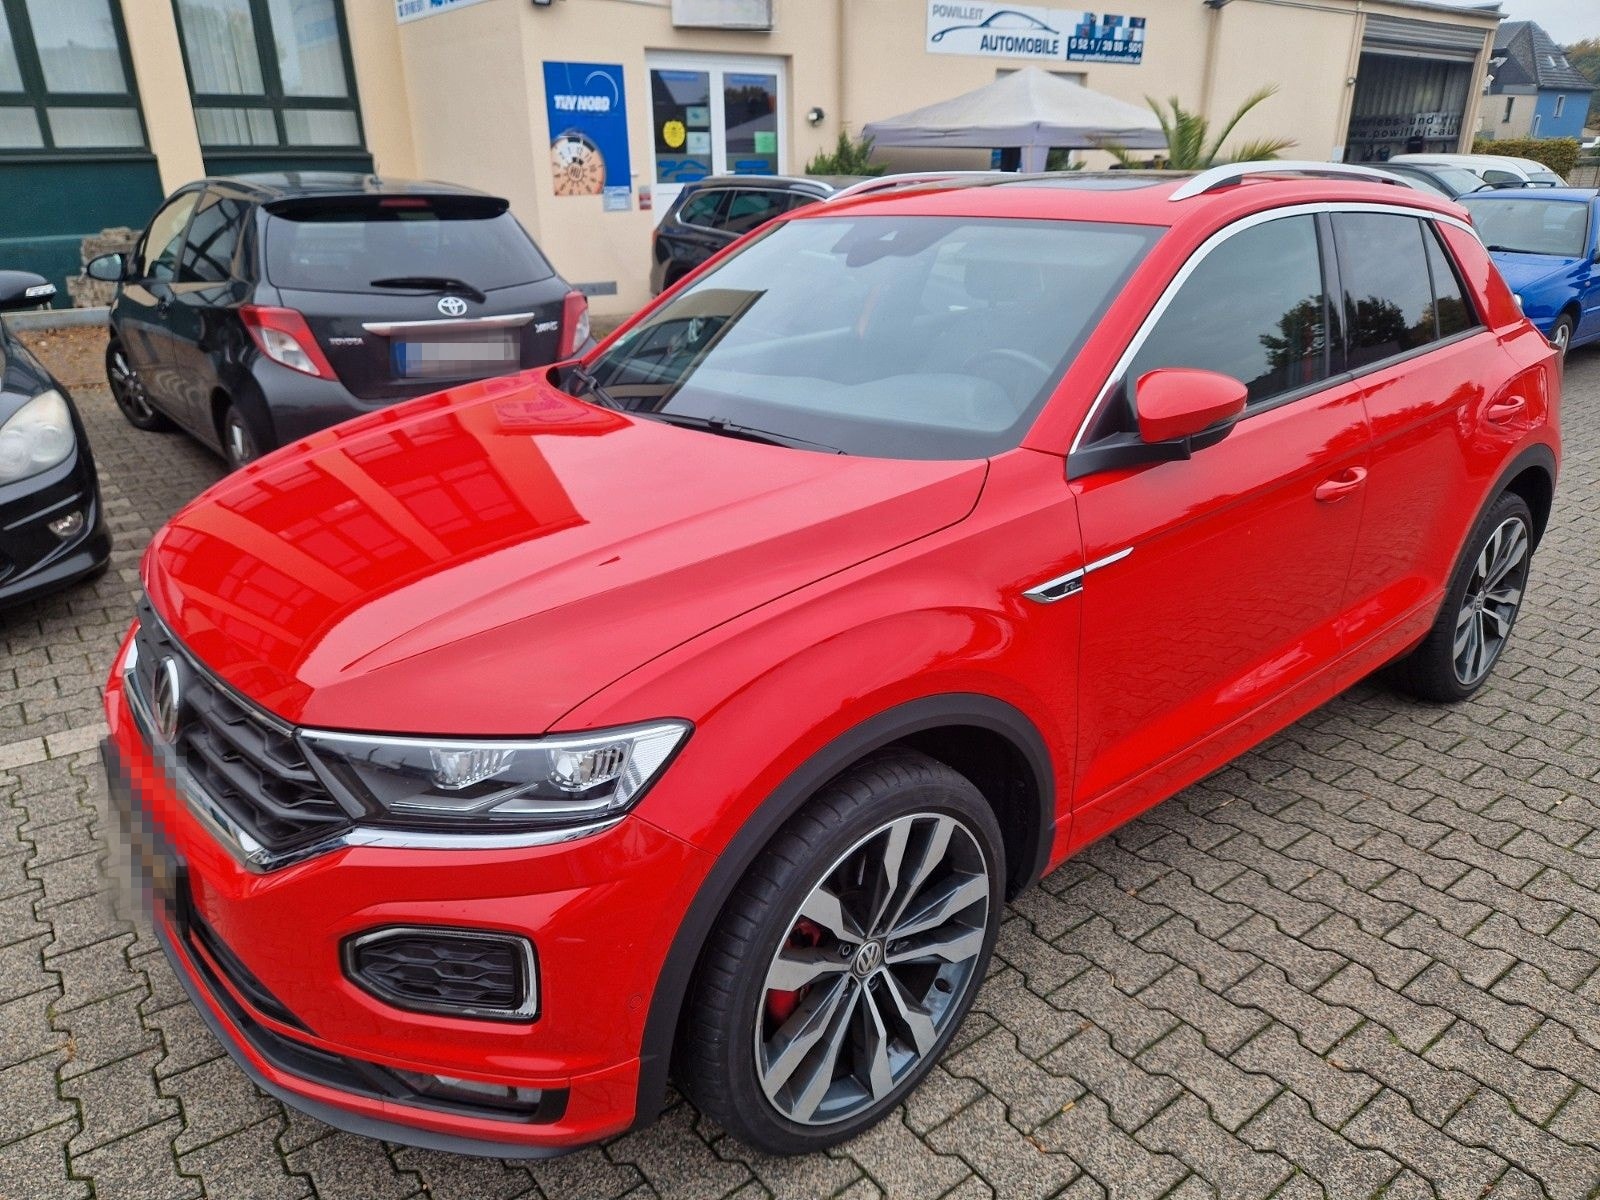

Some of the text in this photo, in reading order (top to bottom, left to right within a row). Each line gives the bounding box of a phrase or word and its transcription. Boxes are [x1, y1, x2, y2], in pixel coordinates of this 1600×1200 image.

[932, 4, 984, 20] POWILLEIT
[980, 34, 1060, 54] AUTOMOBILE
[577, 95, 610, 112] NORD
[1409, 115, 1435, 125] und
[328, 337, 364, 346] TOYOTA
